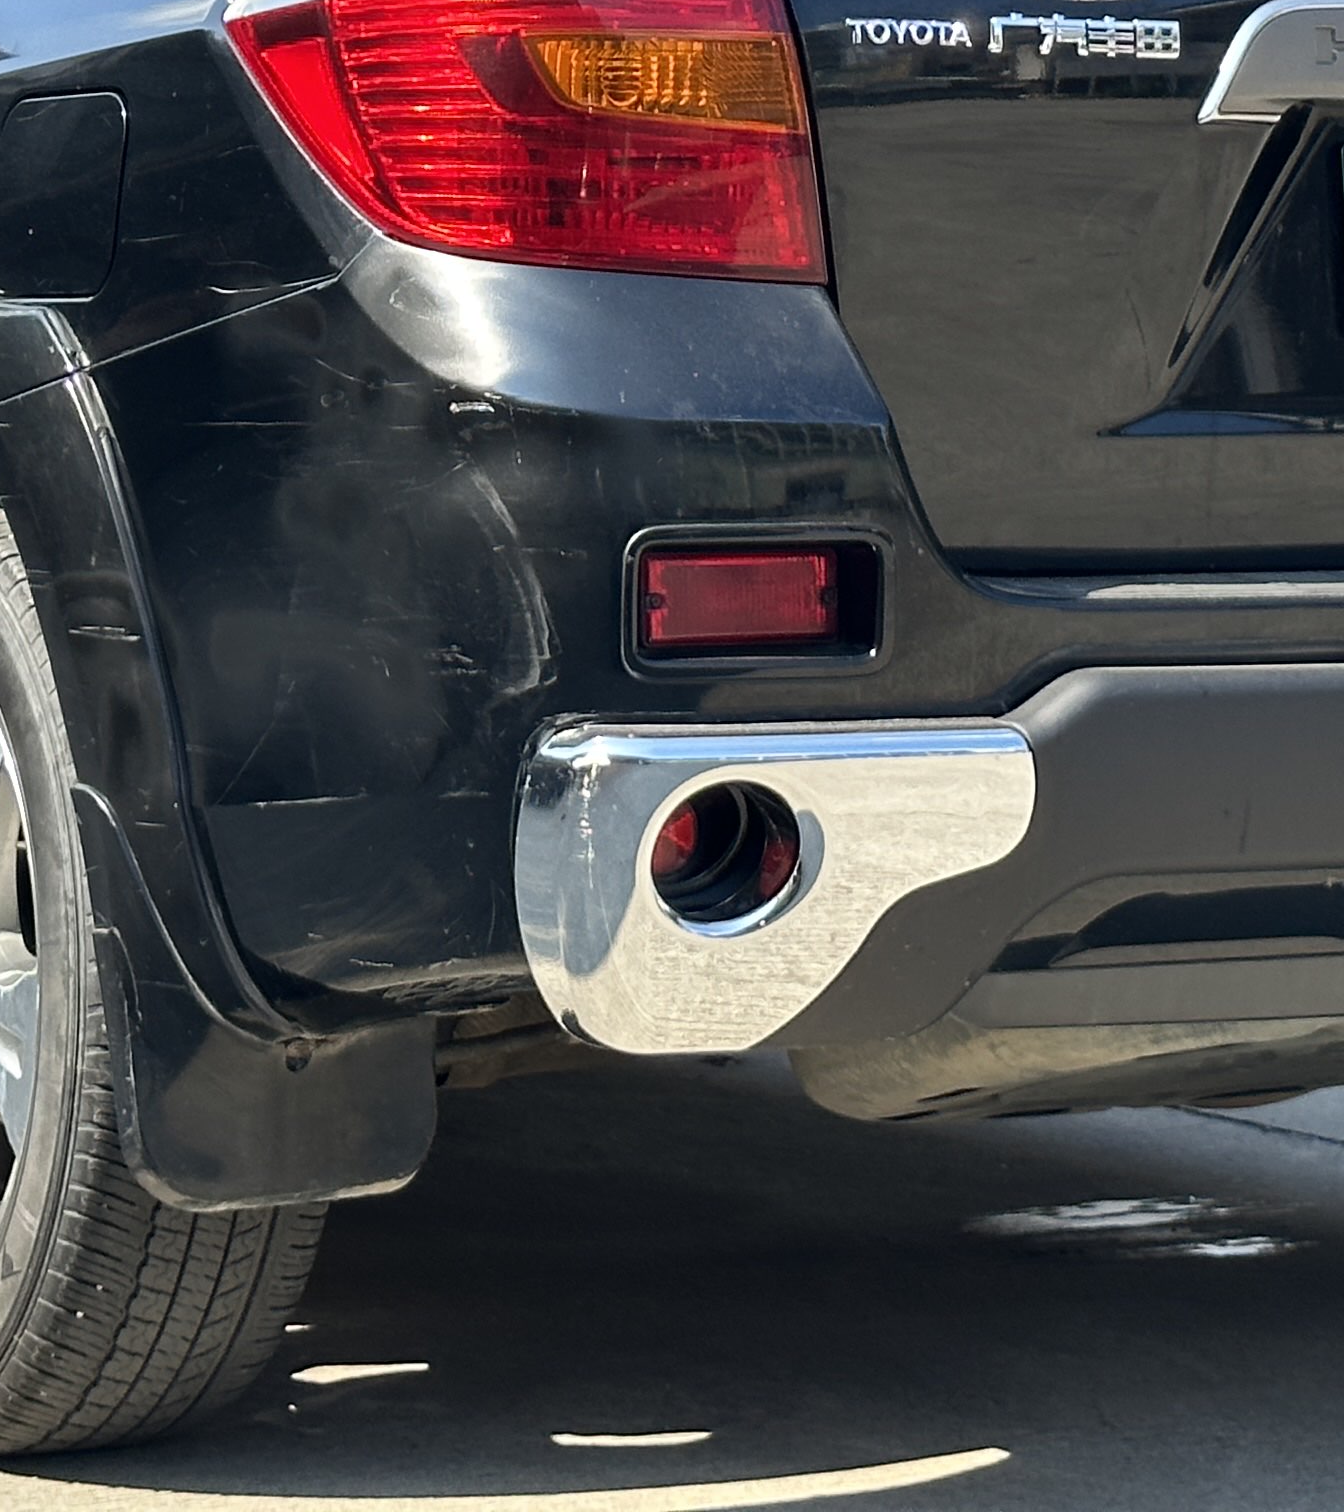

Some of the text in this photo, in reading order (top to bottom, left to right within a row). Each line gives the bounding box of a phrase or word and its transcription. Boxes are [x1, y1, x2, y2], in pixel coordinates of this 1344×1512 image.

[845, 17, 971, 48] TOYOTA
[987, 12, 1180, 59] 广汽丰田
